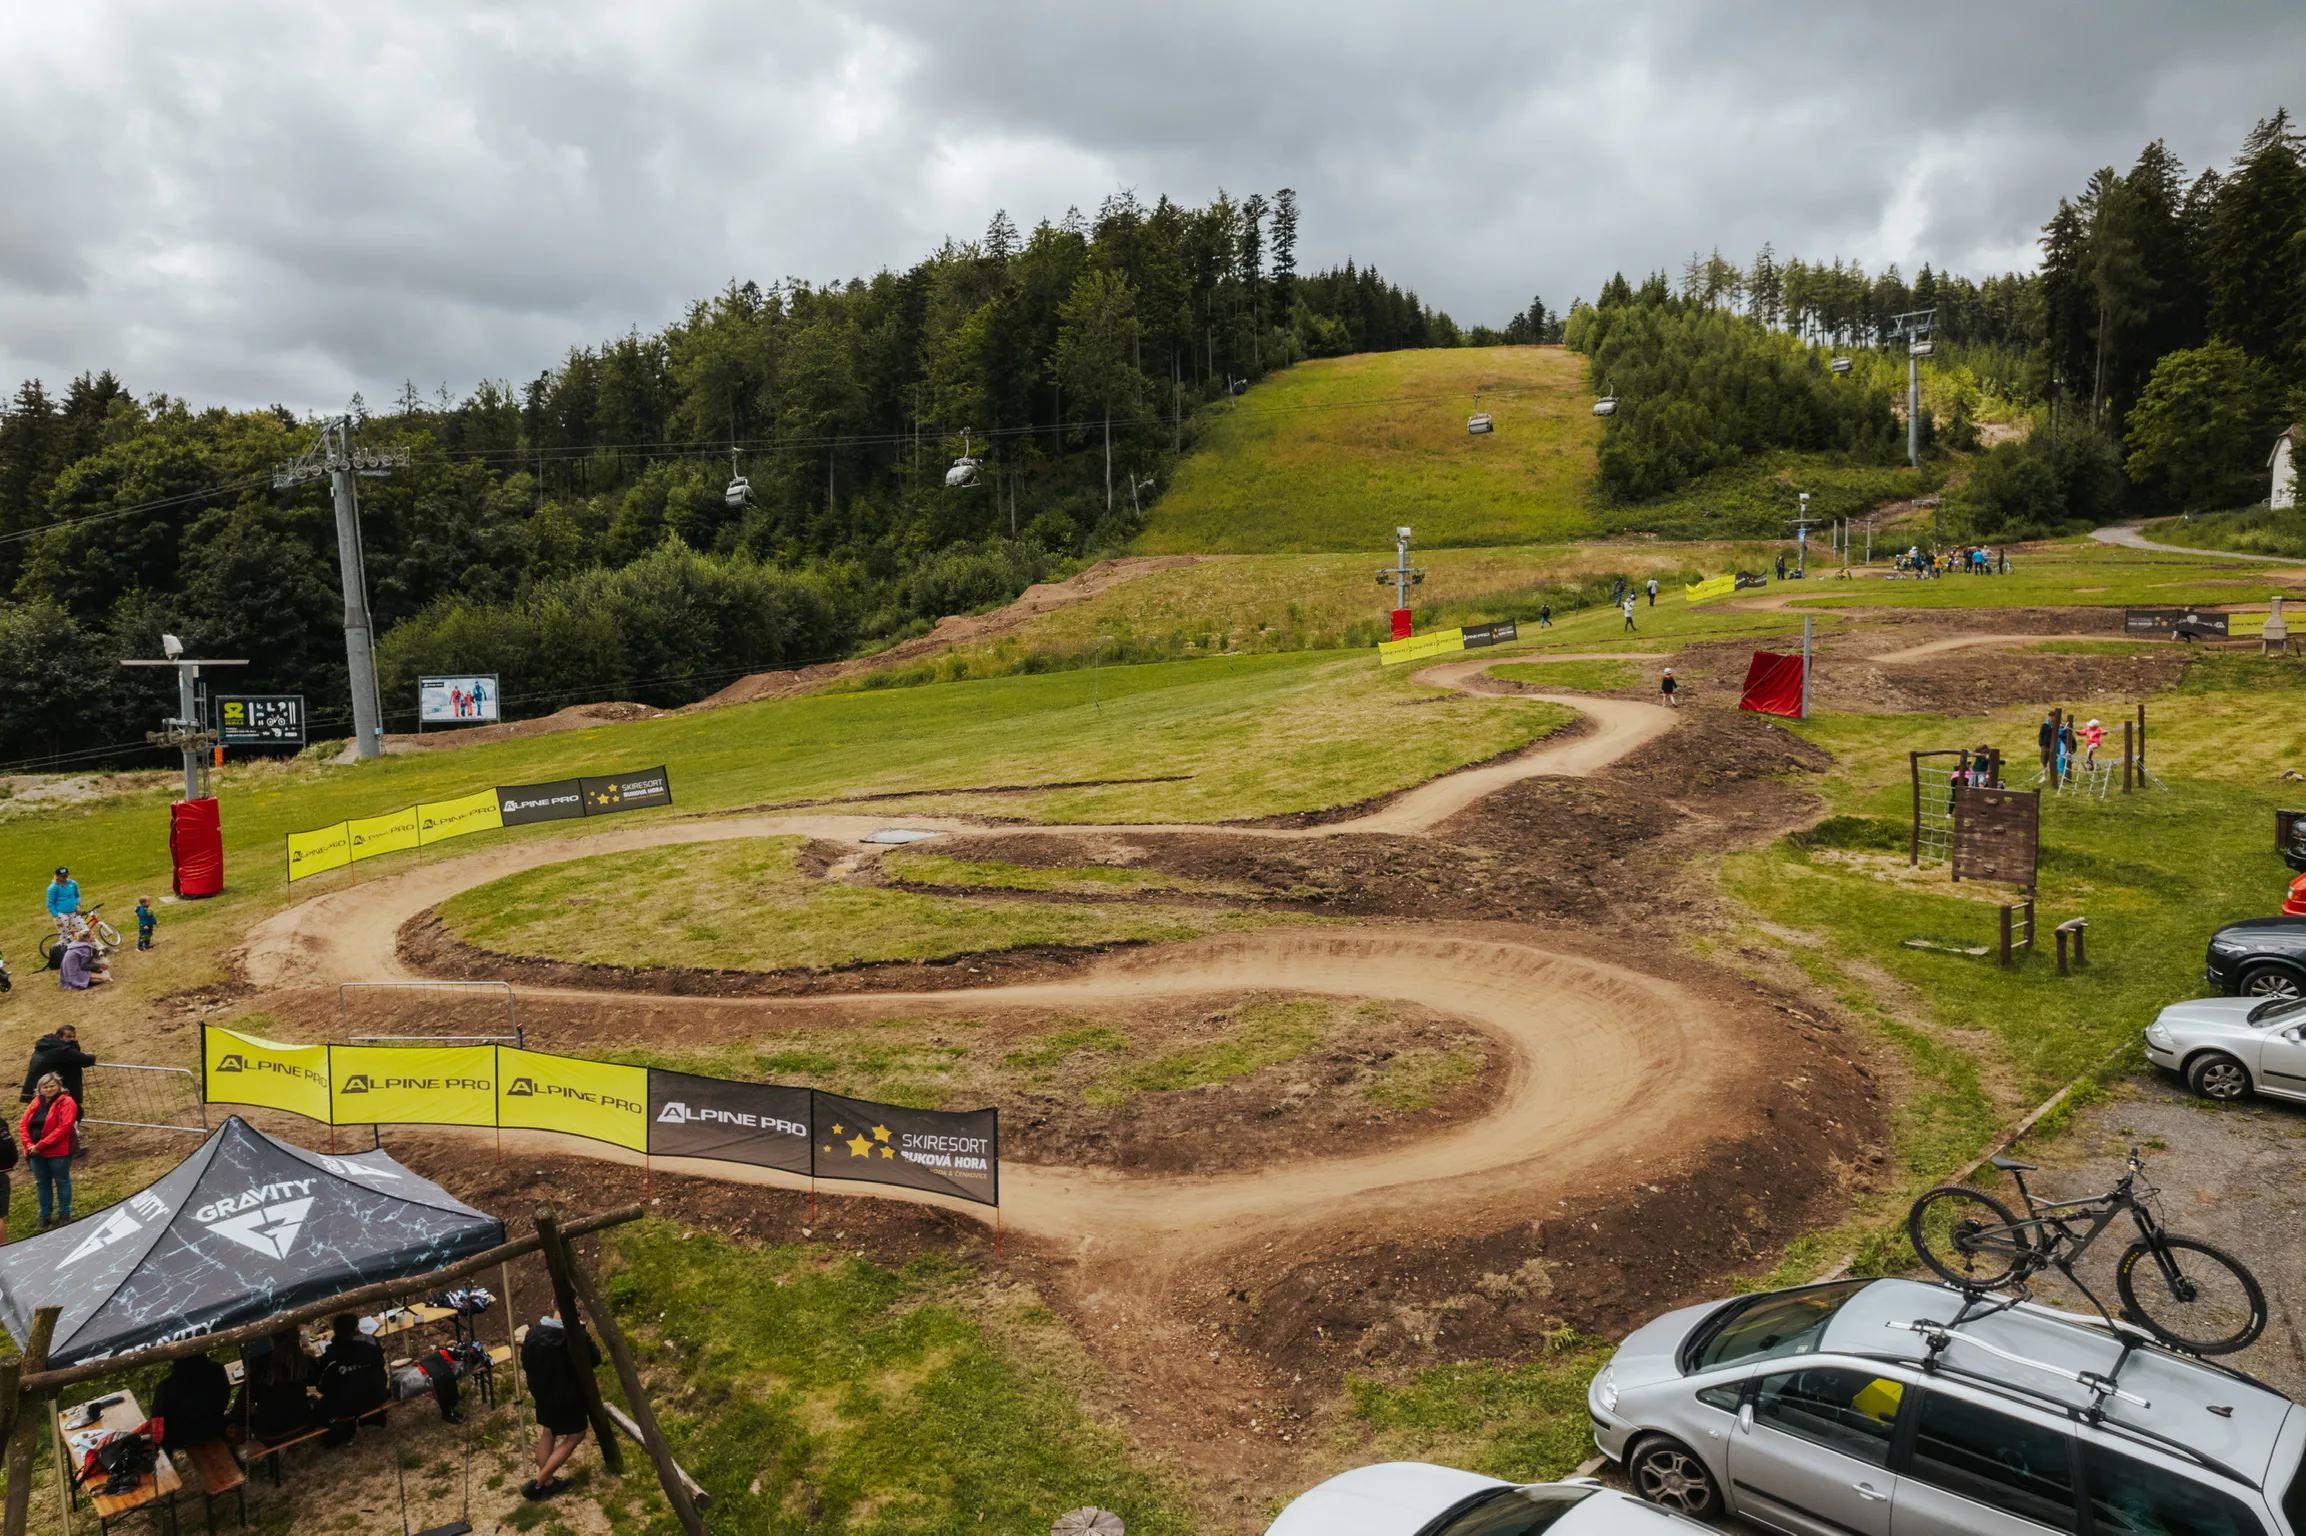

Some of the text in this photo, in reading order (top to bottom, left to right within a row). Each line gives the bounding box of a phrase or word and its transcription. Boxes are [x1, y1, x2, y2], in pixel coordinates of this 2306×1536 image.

[621, 778, 663, 792] SKIRESORT
[503, 794, 579, 812] ALPINE PRO
[215, 1054, 328, 1089] ALPINE PRO
[340, 1074, 491, 1094] ALPINE PRO
[506, 1077, 643, 1115] ALPINE PRO
[656, 1101, 808, 1138] ALPINE PRO
[901, 1133, 988, 1154] SKIRESORT
[943, 1155, 988, 1171] HORA
[196, 1178, 312, 1223] GRAVITY
